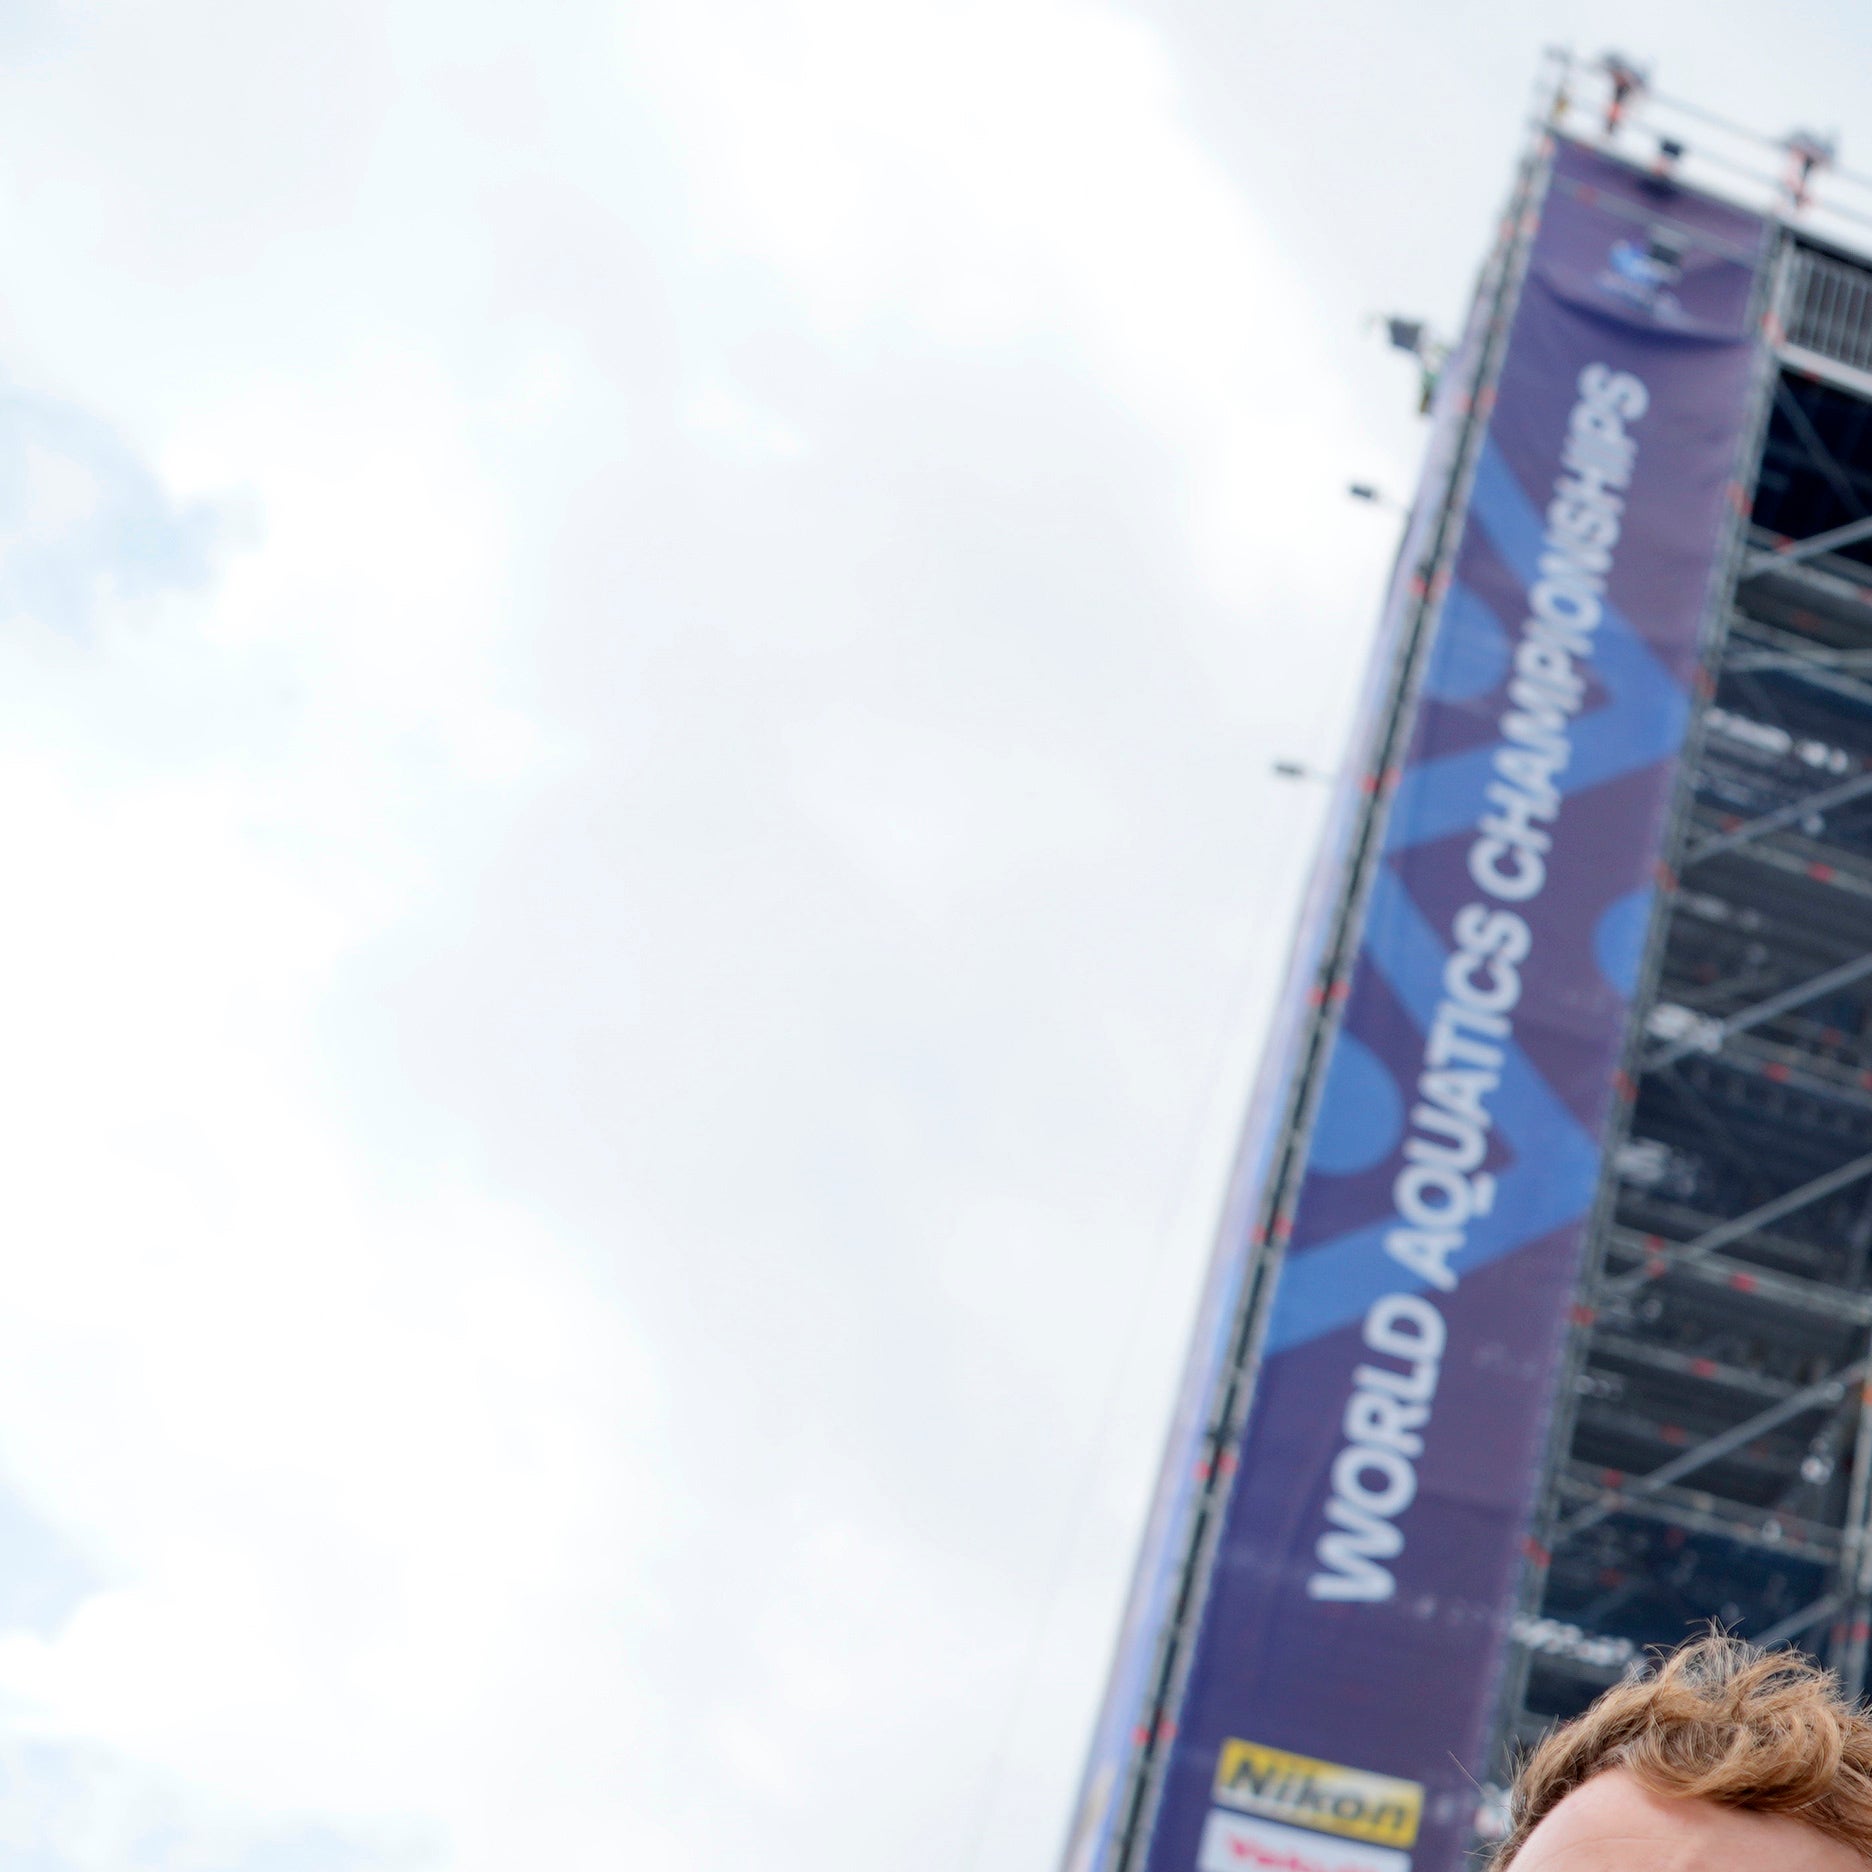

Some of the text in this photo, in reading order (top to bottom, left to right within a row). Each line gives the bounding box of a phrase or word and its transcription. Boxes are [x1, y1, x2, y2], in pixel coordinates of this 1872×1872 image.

[1307, 362, 1650, 1604] WORLD AQUATICS CHAMPIONSHIPS
[1228, 1757, 1414, 1833] Nikon
